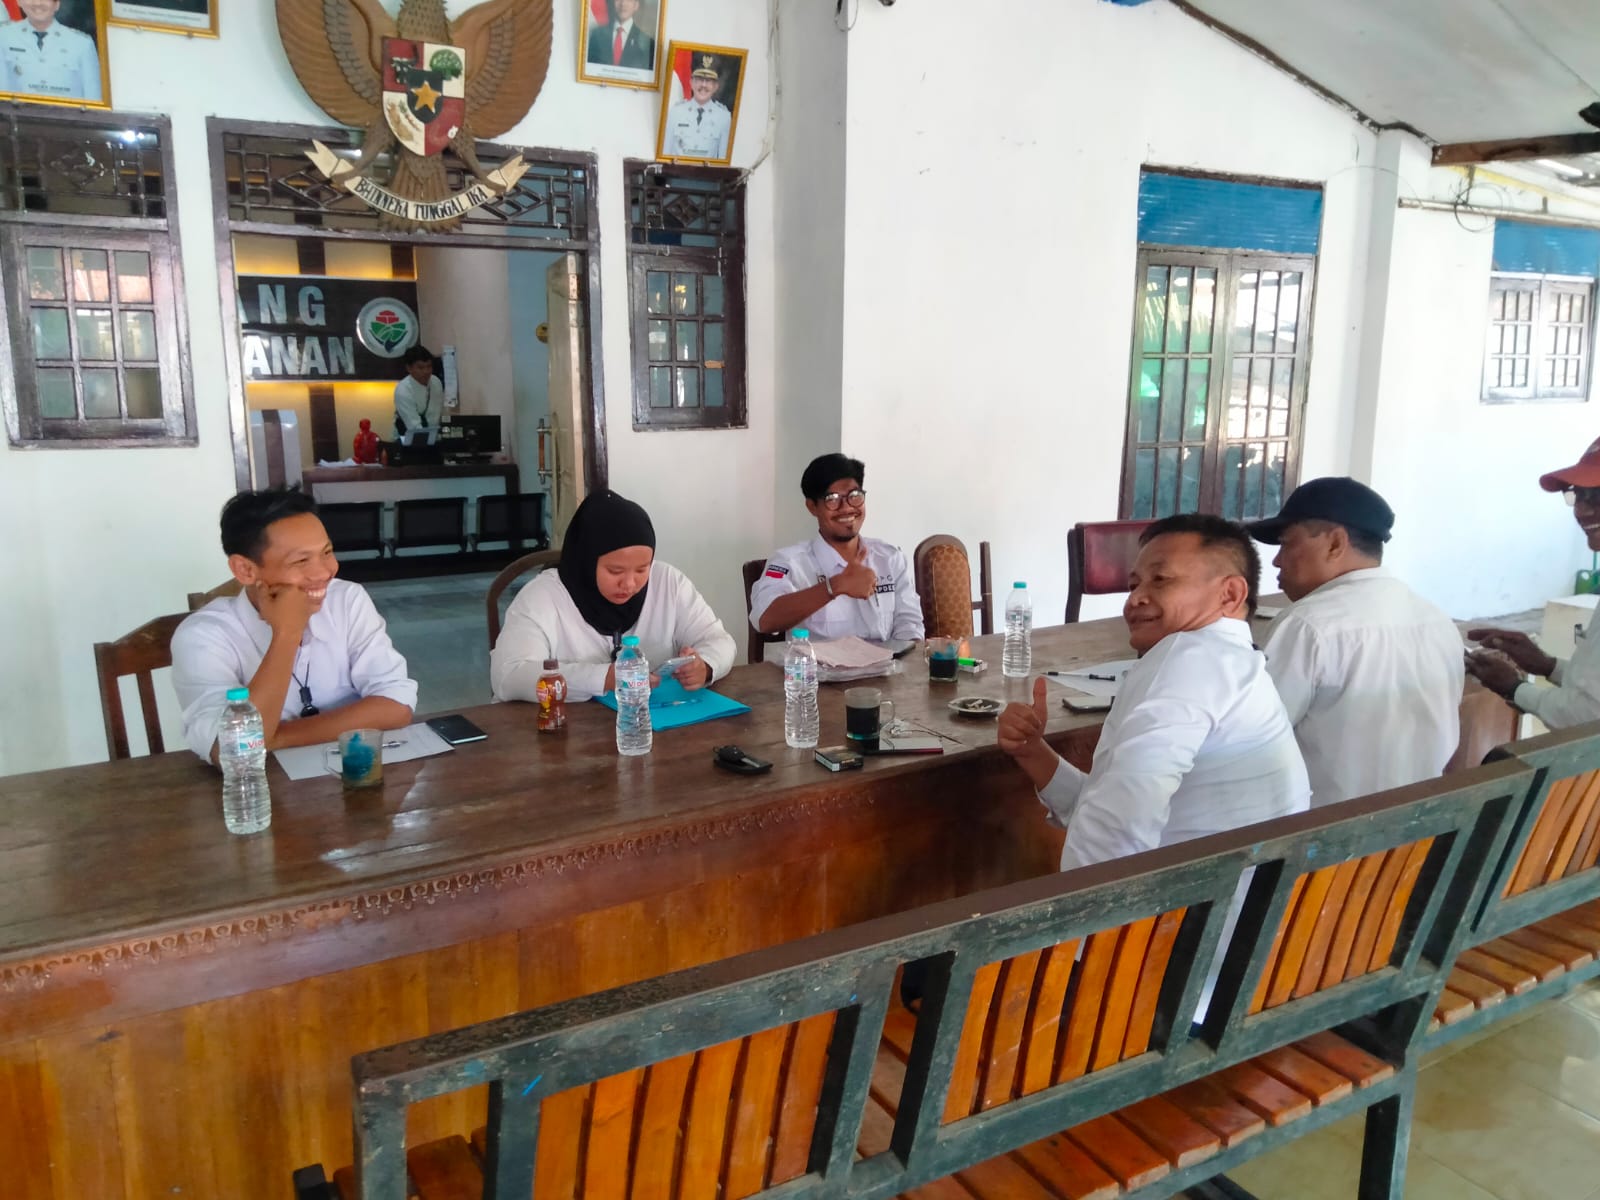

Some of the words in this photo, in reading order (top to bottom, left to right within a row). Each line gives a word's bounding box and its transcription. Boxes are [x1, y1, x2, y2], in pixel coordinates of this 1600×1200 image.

[354, 178, 408, 218] BHINNEKA
[415, 197, 468, 219] TUNGGAL
[467, 186, 488, 207] IKA
